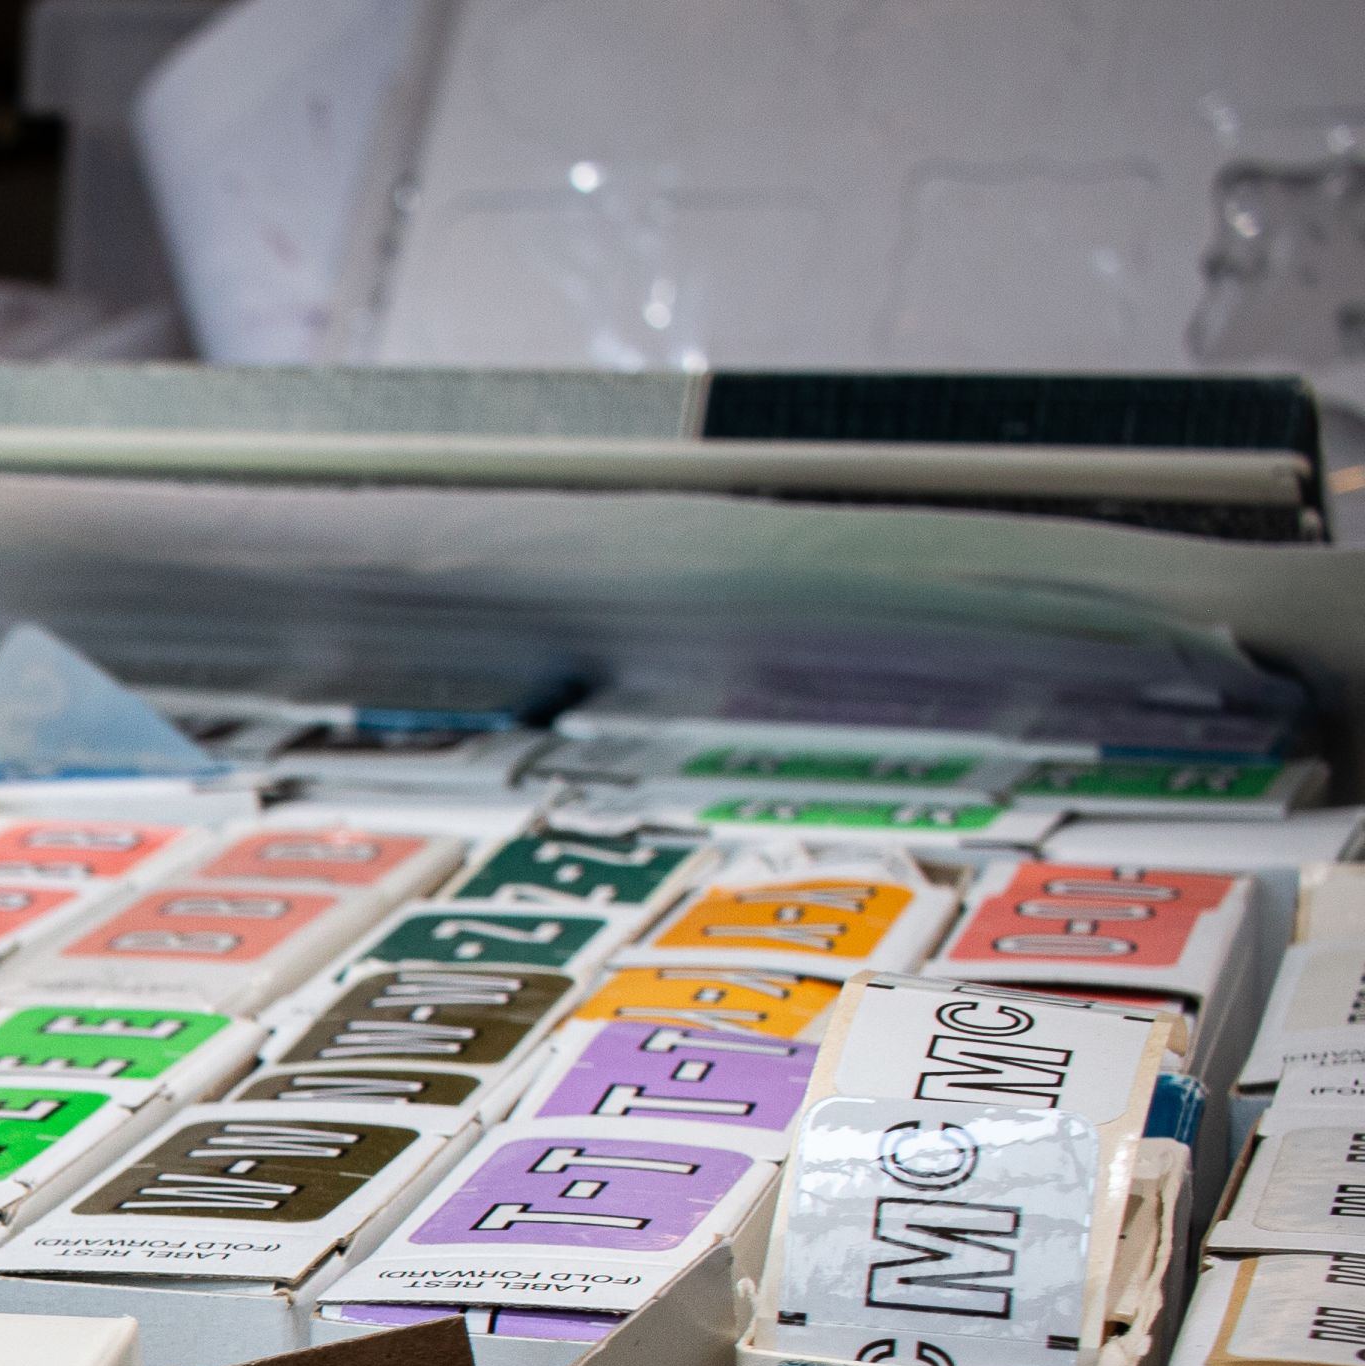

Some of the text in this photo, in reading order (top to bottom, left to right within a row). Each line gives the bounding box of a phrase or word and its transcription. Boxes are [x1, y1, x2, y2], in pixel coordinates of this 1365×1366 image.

[592, 1027, 798, 1117] T-T
[469, 1146, 701, 1232] T-T
[377, 1269, 643, 1286] (FOLD FORWARD)
[401, 1279, 592, 1294] LABEL REST
